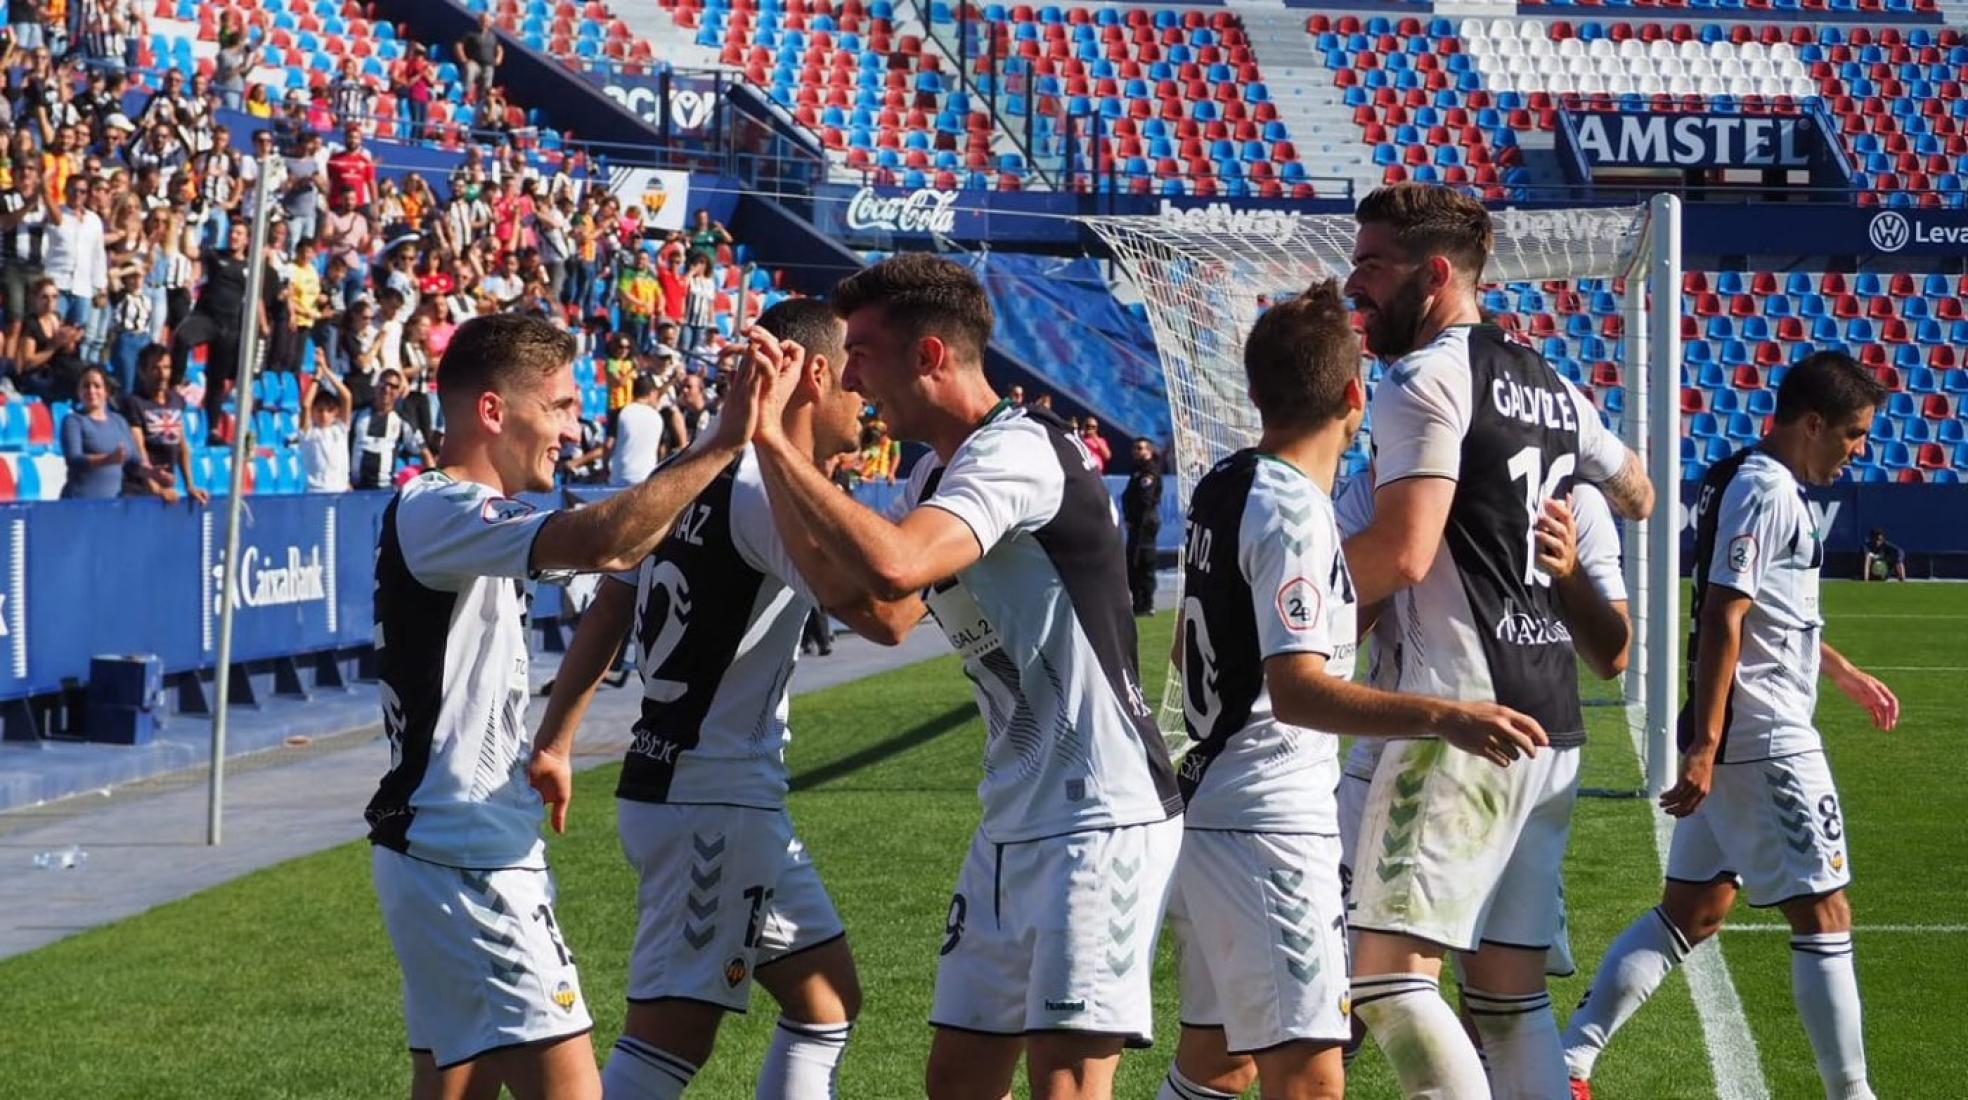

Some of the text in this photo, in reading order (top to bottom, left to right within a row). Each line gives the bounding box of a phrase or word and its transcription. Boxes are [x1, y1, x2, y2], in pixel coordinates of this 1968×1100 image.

[1578, 116, 1809, 165] AMSTEL
[1160, 199, 1300, 244] betway
[1818, 794, 1841, 840] 8
[940, 893, 967, 956] 9
